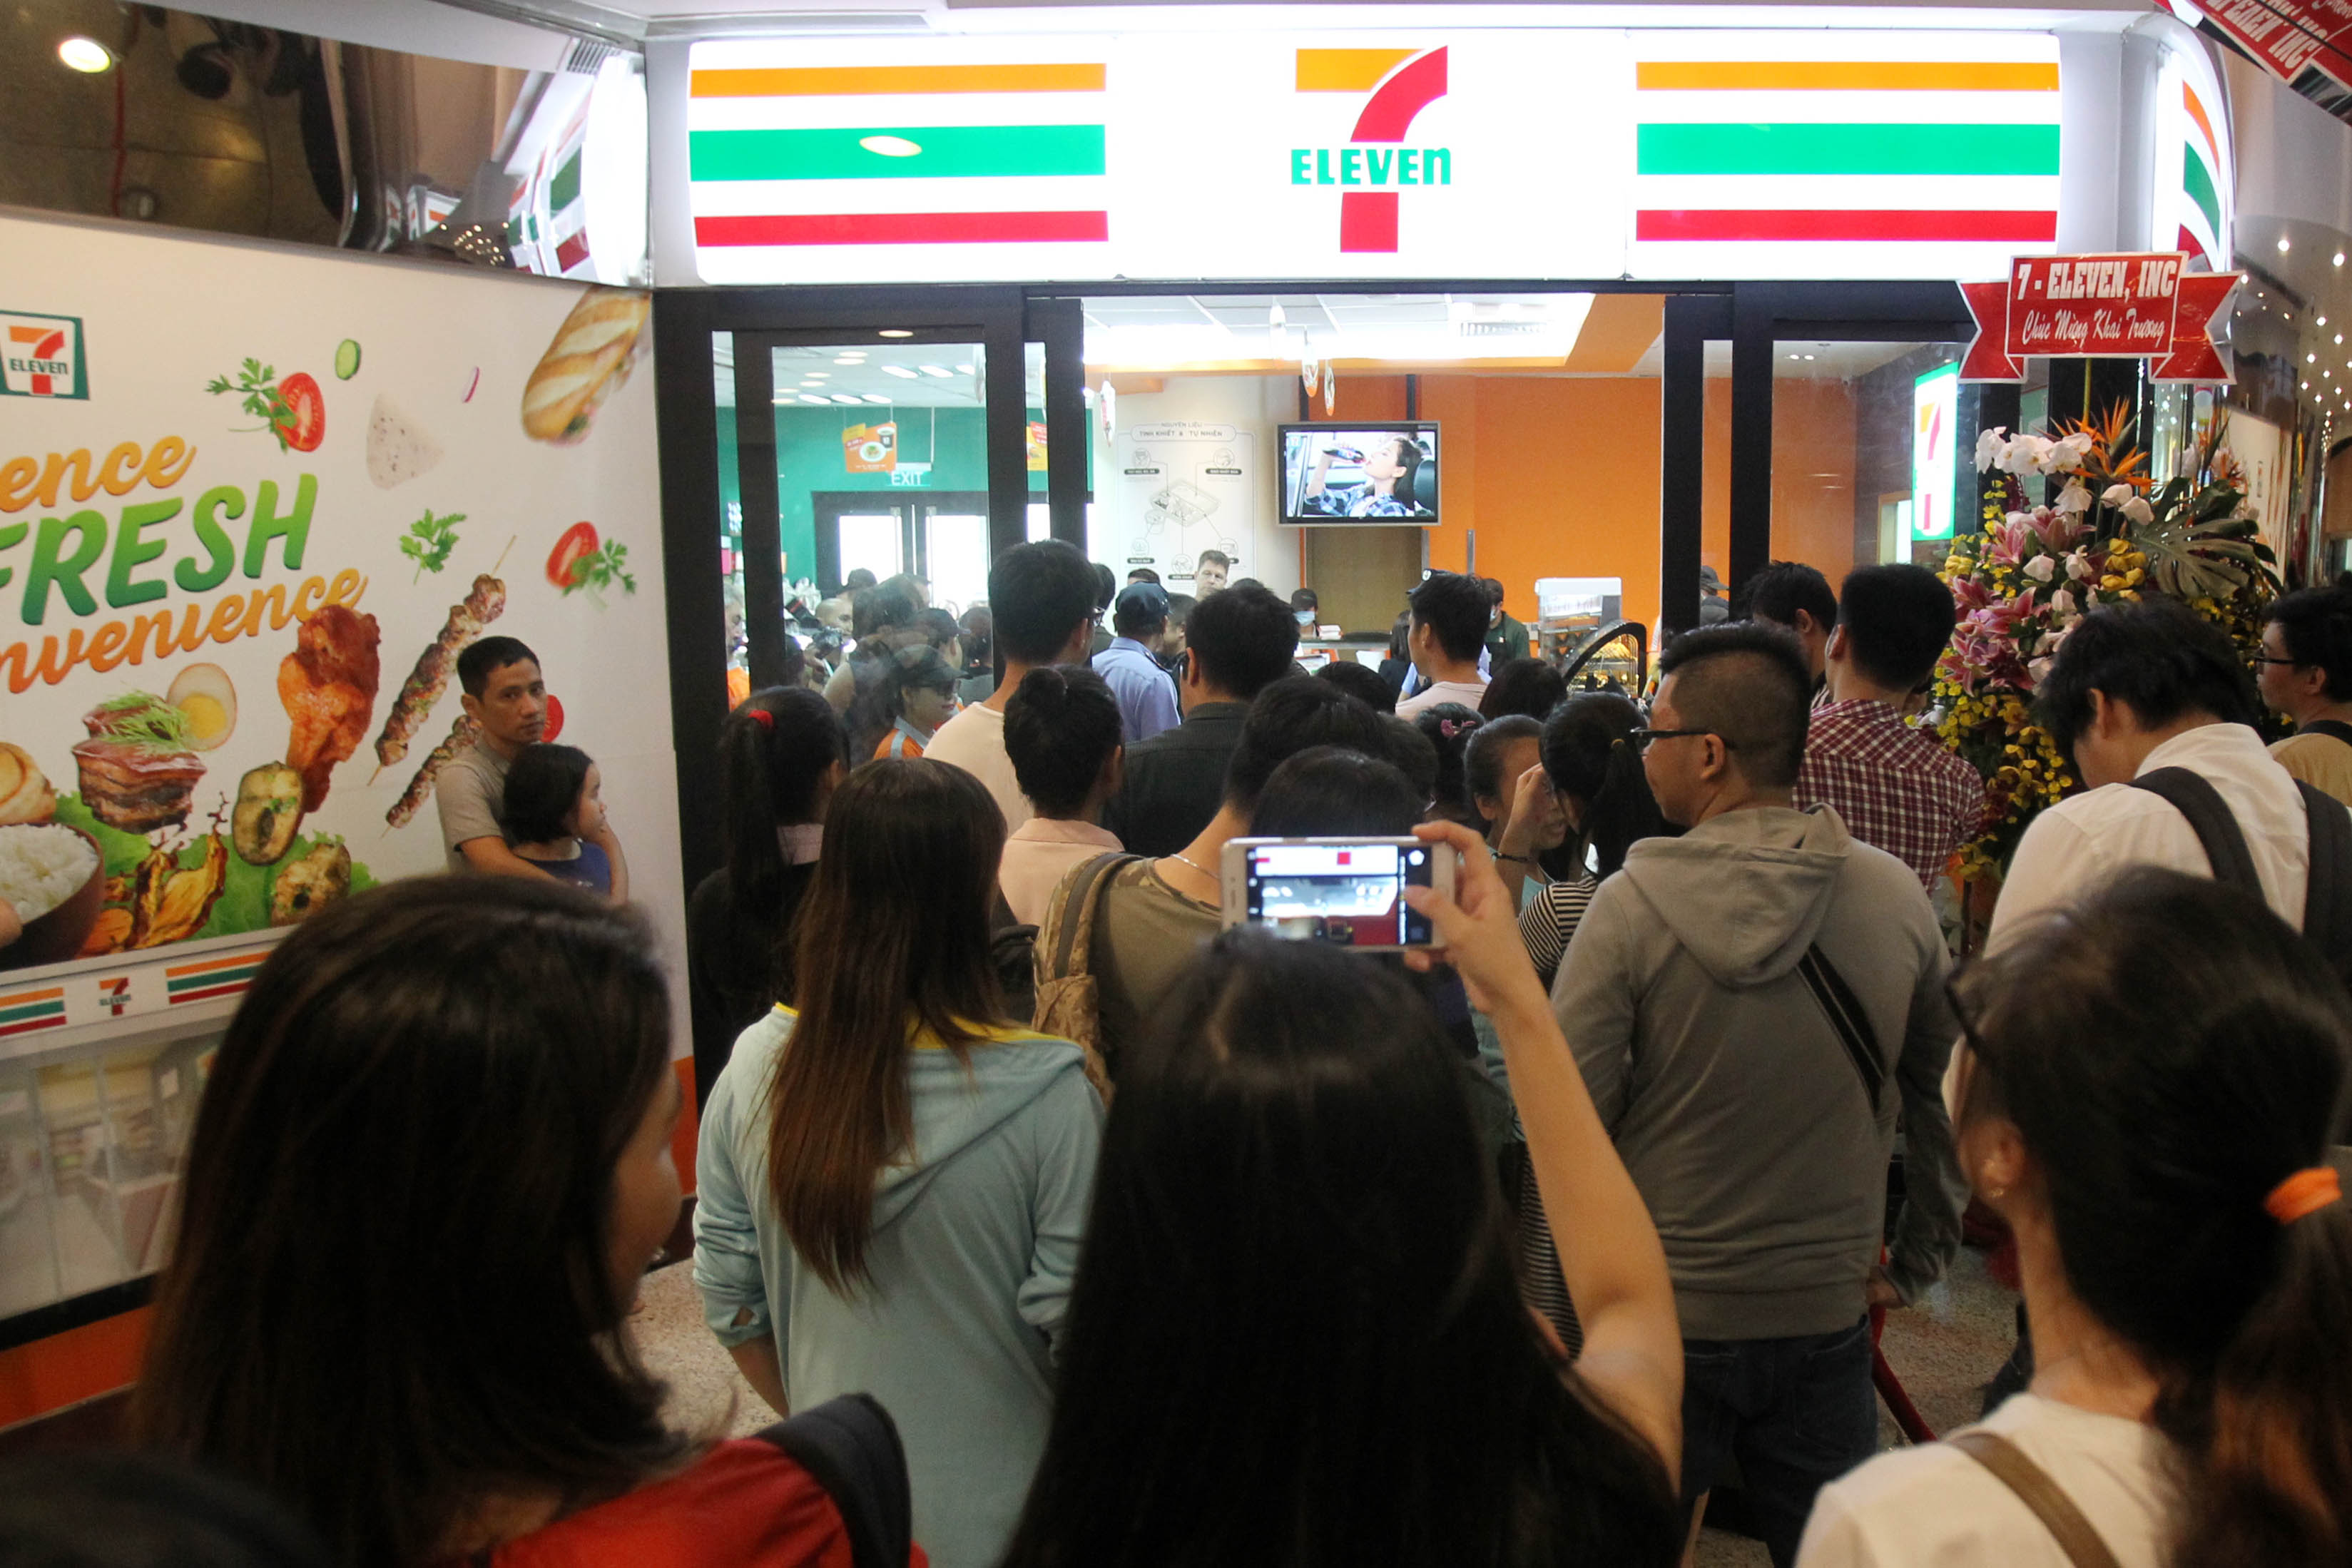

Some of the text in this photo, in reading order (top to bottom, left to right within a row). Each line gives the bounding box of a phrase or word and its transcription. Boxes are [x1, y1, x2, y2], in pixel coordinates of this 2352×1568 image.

[1295, 45, 1447, 253] 7
[2017, 263, 2032, 300] 7
[2047, 261, 2128, 302] ELEVEN,
[2137, 260, 2177, 297] INC
[2092, 308, 2123, 340] Khai
[9, 325, 66, 395] 7
[891, 471, 923, 486] EXIT
